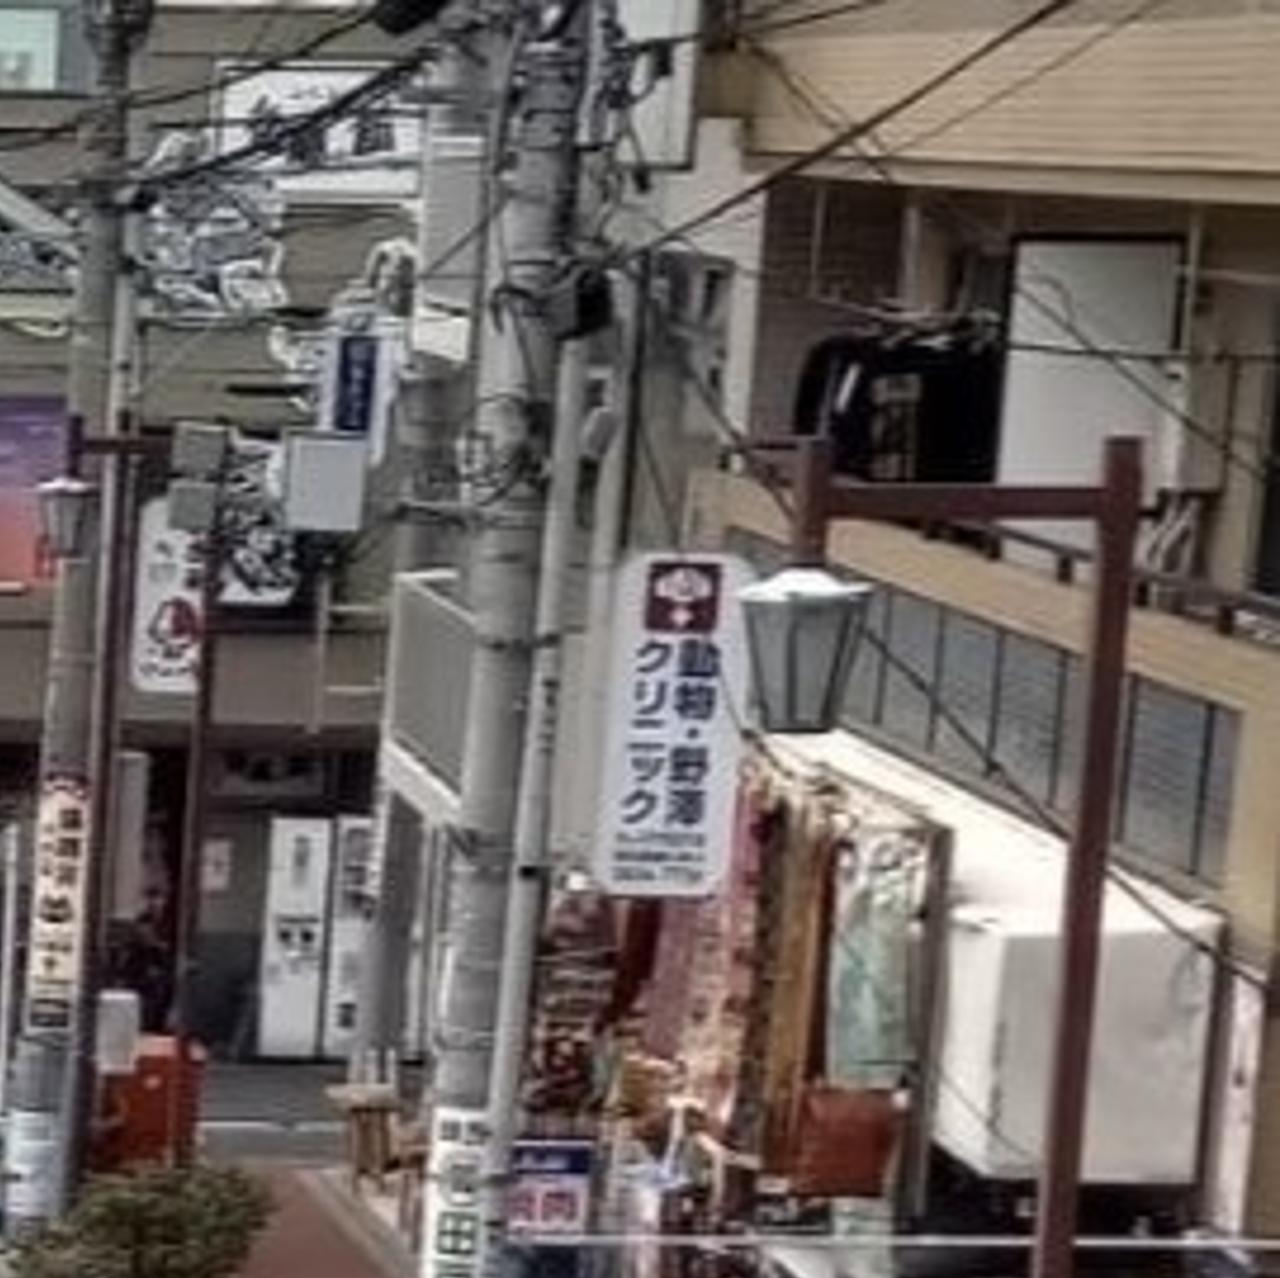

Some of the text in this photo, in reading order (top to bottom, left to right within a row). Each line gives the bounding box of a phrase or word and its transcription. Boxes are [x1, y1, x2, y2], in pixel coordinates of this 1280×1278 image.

[621, 641, 671, 824] クリニック
